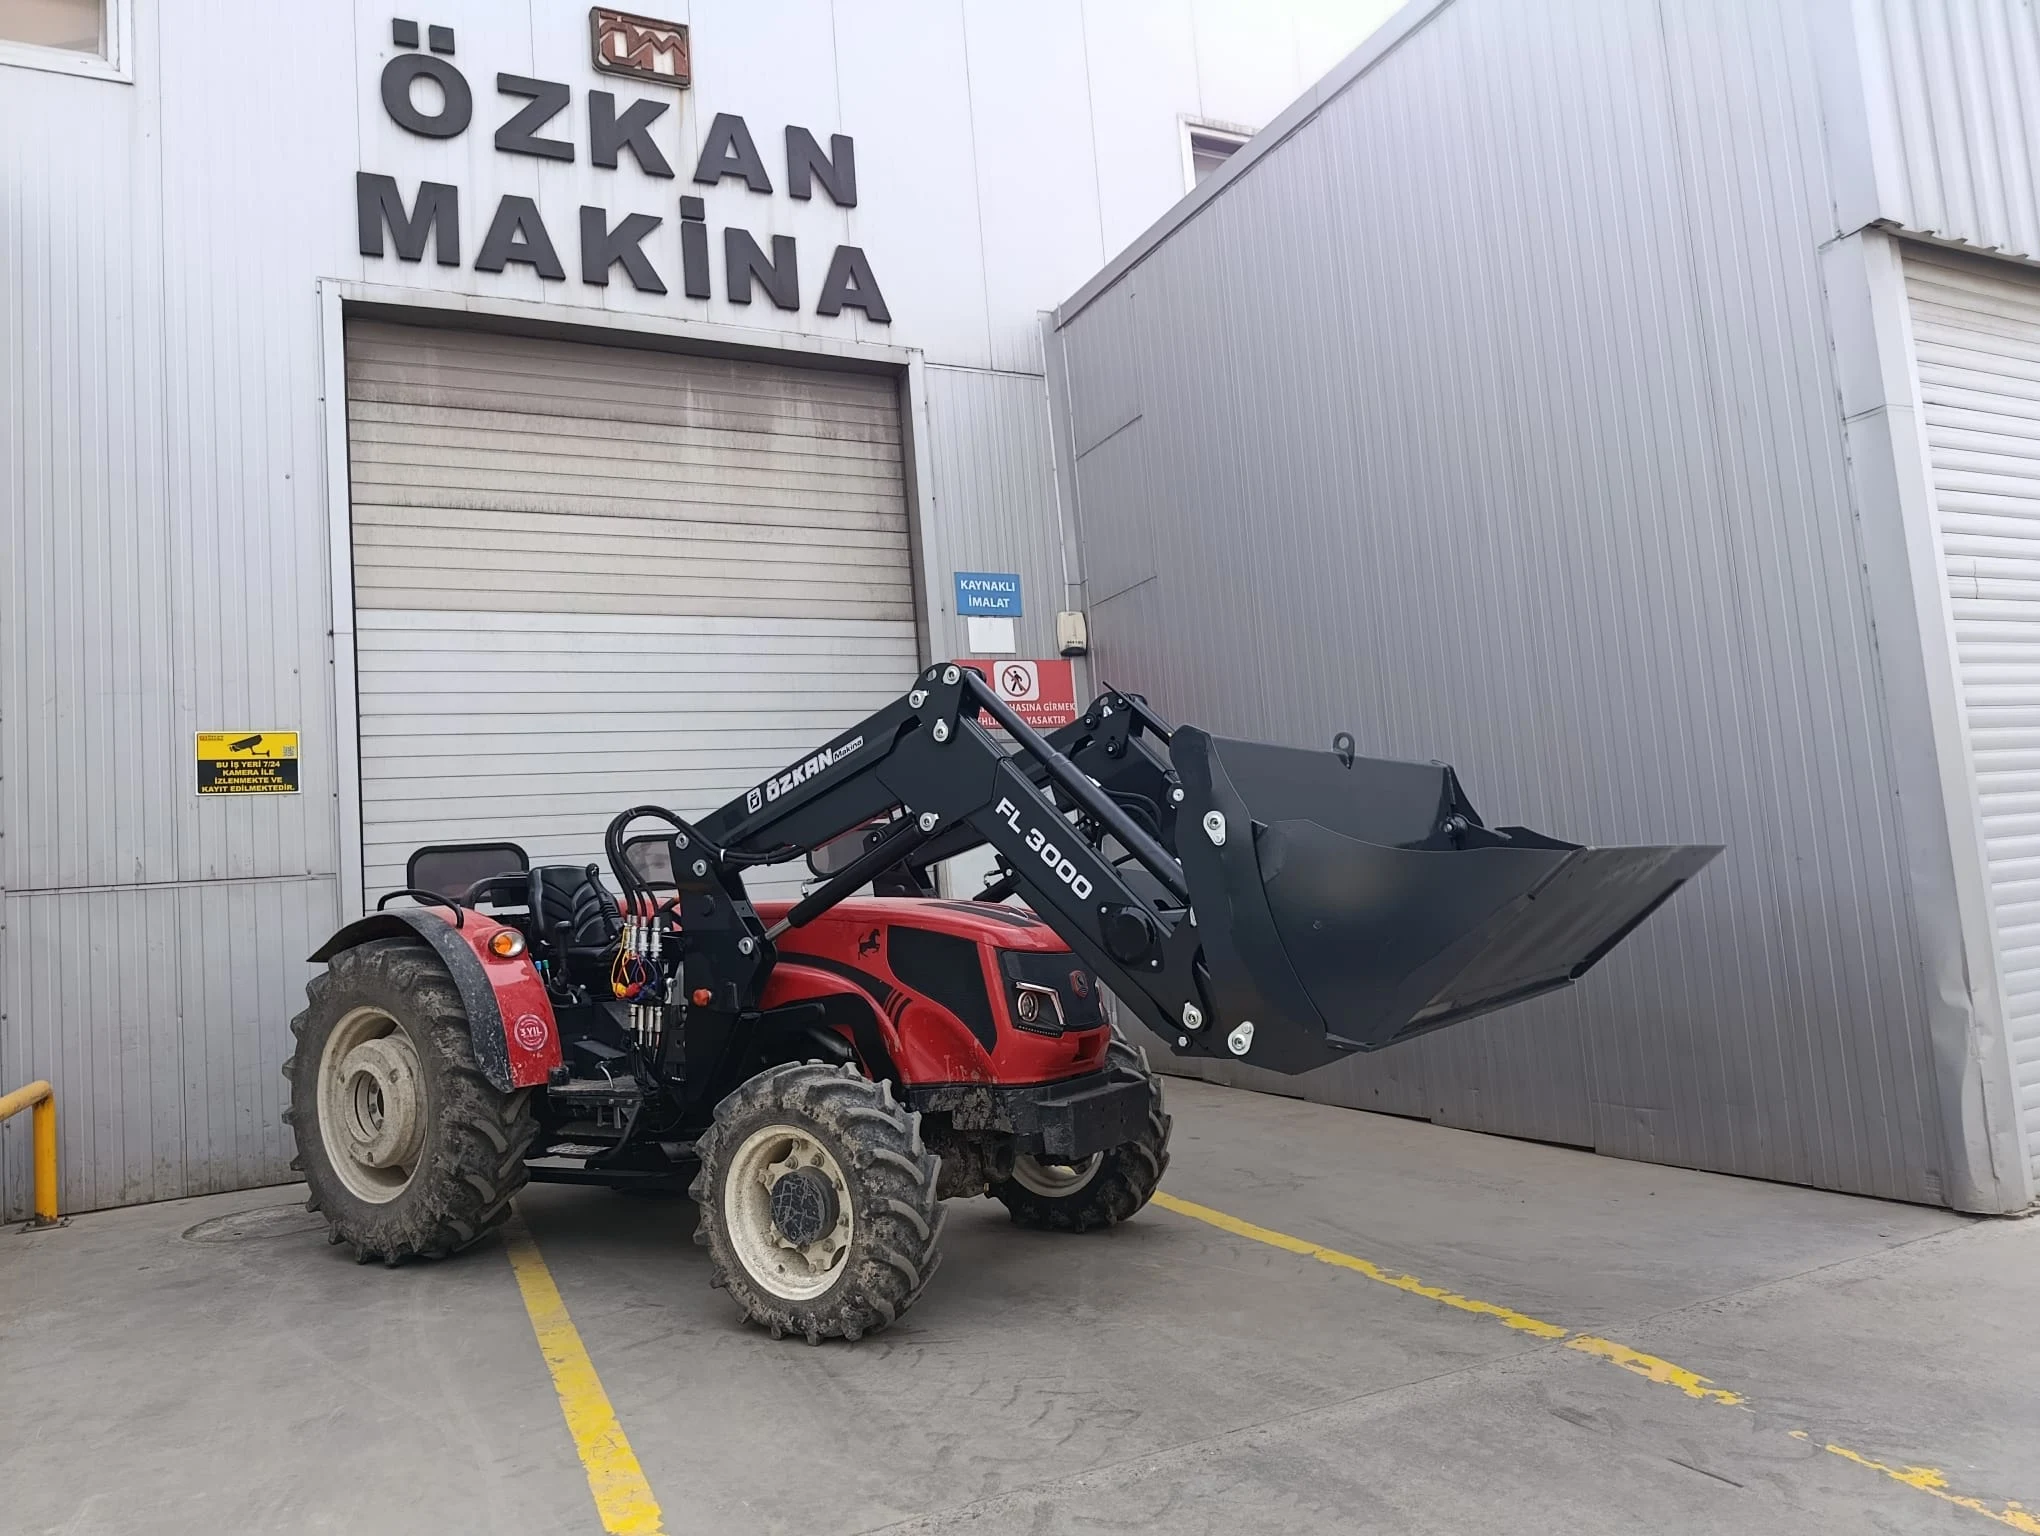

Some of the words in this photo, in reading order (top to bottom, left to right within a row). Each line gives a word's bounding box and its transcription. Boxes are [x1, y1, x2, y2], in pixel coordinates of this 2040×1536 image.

[380, 17, 858, 208] ÖZKAN
[356, 171, 892, 326] MAKİNA
[960, 579, 1016, 592] KAYNAKLI
[968, 594, 1011, 608] İMALAT
[1008, 703, 1041, 711] HASINA
[1043, 701, 1076, 711] GİRMEK
[1026, 715, 1067, 725] YASAKTIR
[216, 761, 229, 769] BU
[241, 760, 261, 768] YERİ
[263, 760, 281, 768] 7/24
[766, 747, 834, 802] ÖZKAN
[834, 738, 863, 761] Makina
[260, 768, 275, 776] İLE
[214, 776, 270, 785] İZLENMEKTE
[271, 776, 283, 784] VE
[201, 785, 228, 793] KAYIT
[995, 797, 1021, 834] FL
[1025, 827, 1093, 900] 3000
